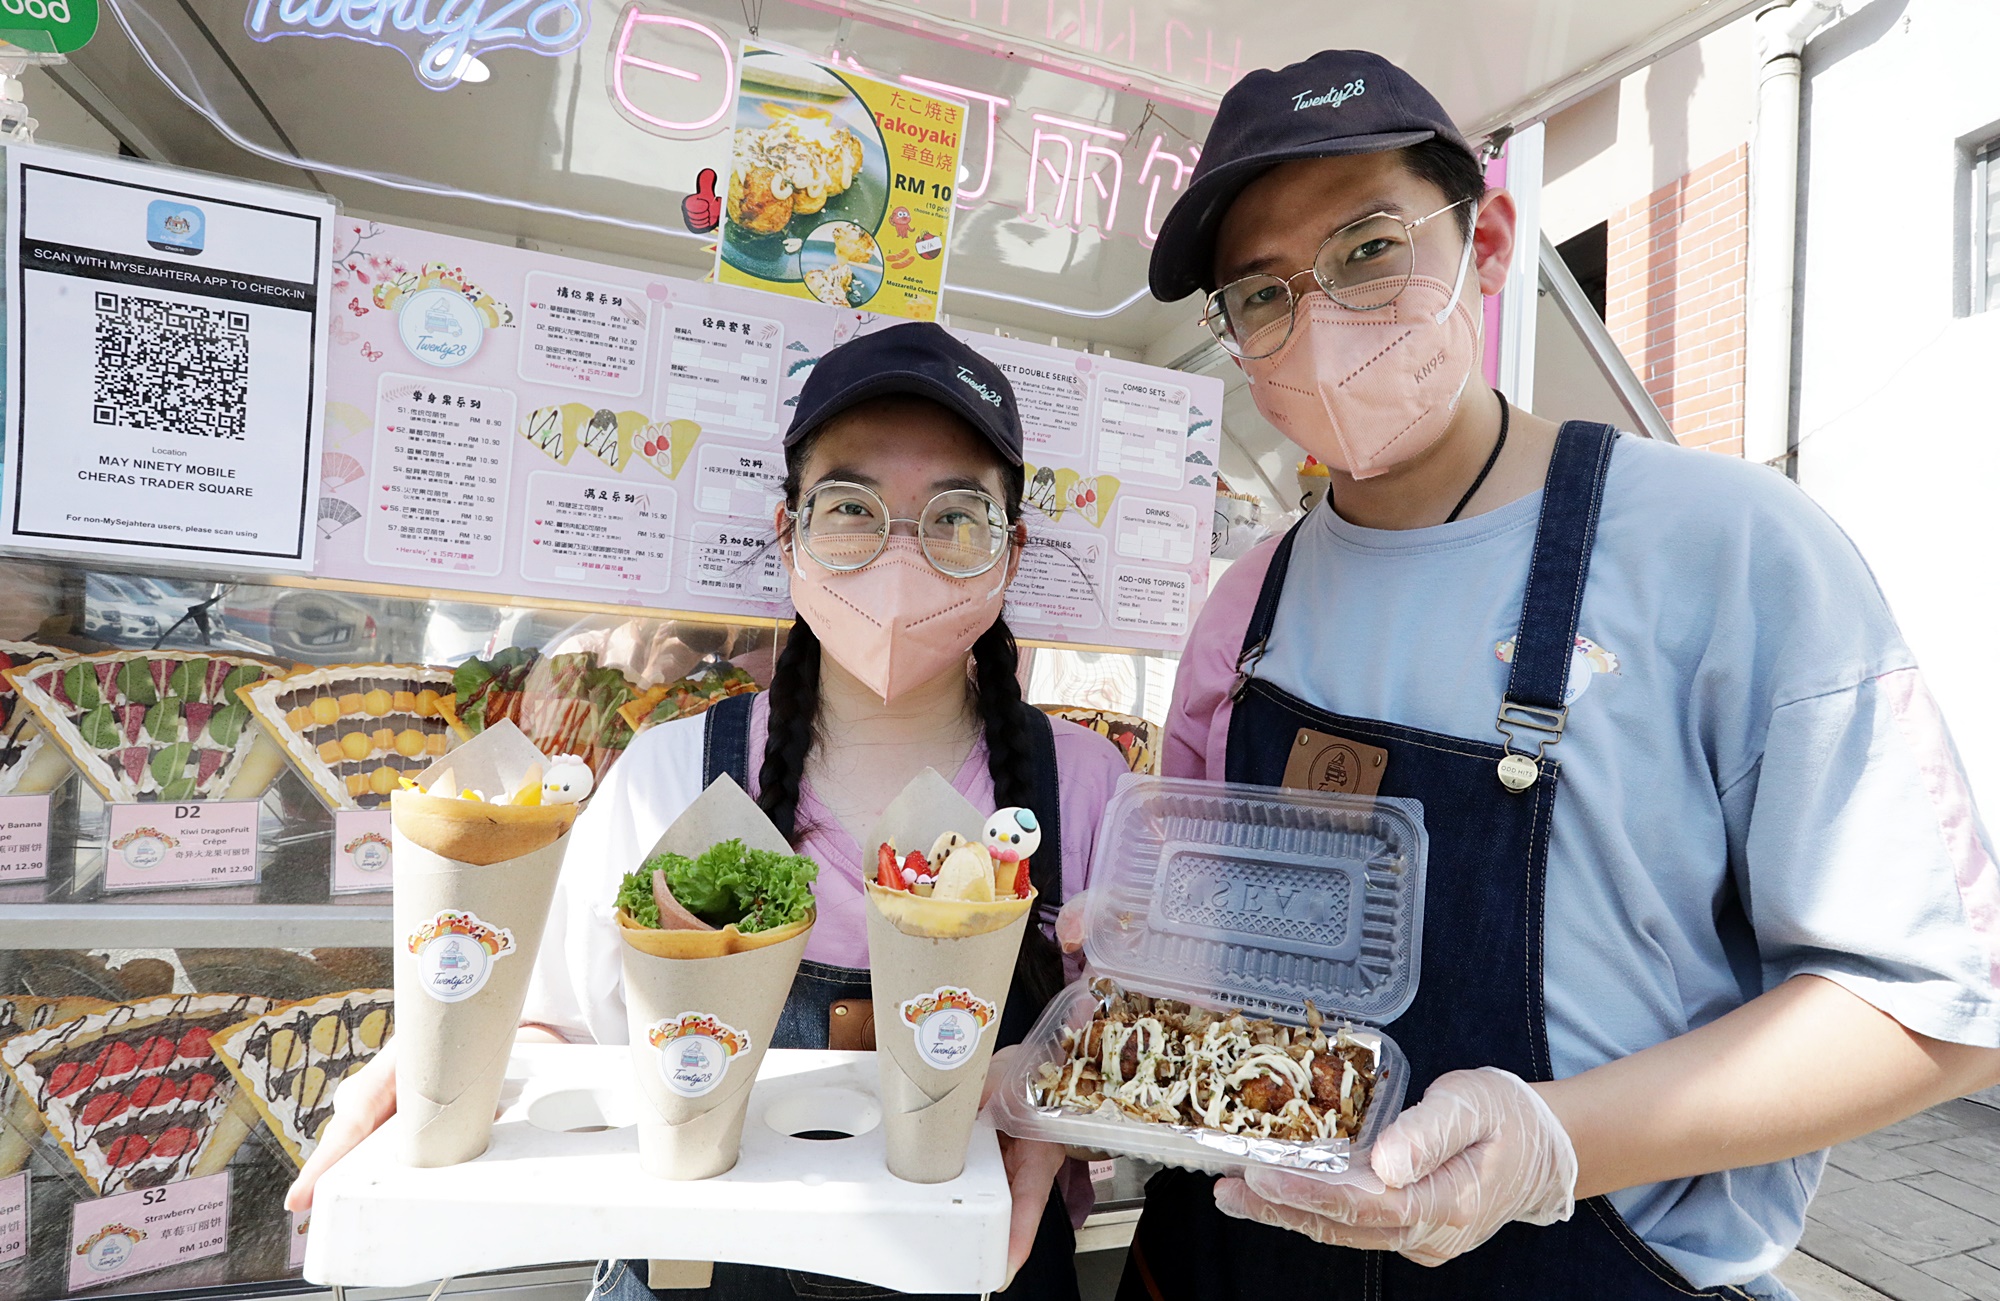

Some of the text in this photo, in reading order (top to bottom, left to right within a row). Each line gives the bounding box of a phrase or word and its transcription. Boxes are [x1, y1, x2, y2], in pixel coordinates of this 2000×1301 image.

[0, 0, 71, 24] ood
[1291, 78, 1366, 112] Twenty28
[890, 91, 957, 125] たこ焼き
[874, 111, 957, 148] Takoyaki
[901, 143, 952, 172] 章鱼烧
[895, 174, 951, 201] RM 10
[914, 208, 930, 216] choose
[926, 202, 936, 210] (10
[922, 242, 934, 250] N/A
[34, 248, 305, 300] SCAN WITH MYSEJAHTERA APP TO CHECK-IN
[903, 276, 923, 284] Add-on
[886, 280, 938, 295] Mozzarella Cheese
[556, 286, 623, 307] 情侣果系列
[702, 318, 751, 335] 经典套餐
[416, 335, 467, 360] Twenty28
[996, 362, 1077, 383] WEET DOUBLE SERIES
[1414, 351, 1445, 384] KN95
[956, 366, 1002, 408] Twenty28
[1123, 383, 1165, 397] COMBO SETS
[412, 390, 481, 409] 单身果系列
[152, 446, 187, 457] Location
[99, 455, 236, 479] MAY NINETY MOBILE
[740, 458, 763, 468] 饮料
[78, 470, 253, 497] CHERAS TRADER SQUARE
[584, 488, 635, 503] 满足系列
[1146, 508, 1170, 517] DRINKS
[66, 514, 81, 522] For
[83, 516, 156, 530] non-MySejahtera
[158, 523, 184, 532] users,
[185, 525, 212, 535] please
[236, 530, 258, 539] using
[719, 534, 766, 548] 另加配料
[1047, 540, 1071, 548] SERIES
[1119, 576, 1185, 589] ADD-ONS TOPPINGS
[175, 806, 200, 819] D2
[175, 847, 250, 859] 奇异火龙果可丽饼
[15, 862, 43, 870] 12.90
[432, 972, 474, 990] Twenty28
[930, 1042, 968, 1058] Twenty28
[671, 1068, 712, 1085] Twenty28
[142, 1188, 166, 1206] S2
[144, 1200, 223, 1224] Strawberry Crêpe
[160, 1216, 222, 1240] 草莓可丽饼
[179, 1237, 223, 1254] RM 10.90
